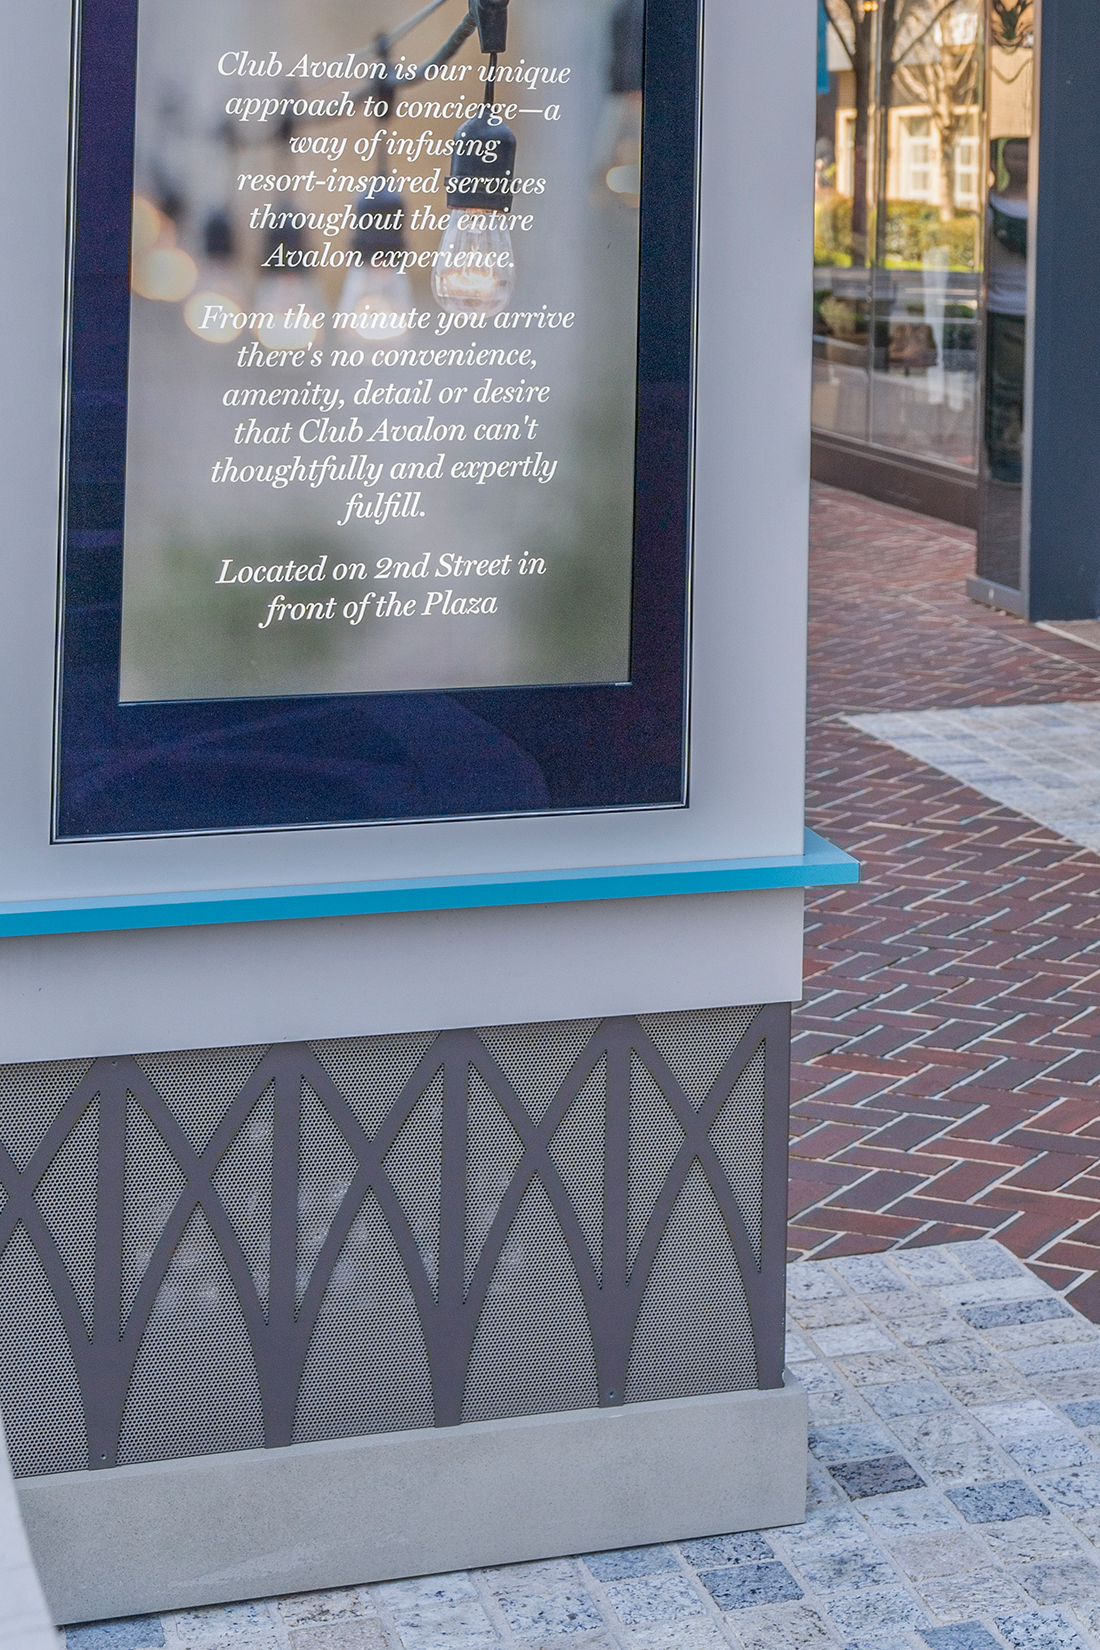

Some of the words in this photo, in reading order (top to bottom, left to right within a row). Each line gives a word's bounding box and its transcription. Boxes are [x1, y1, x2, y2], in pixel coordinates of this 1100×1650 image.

[218, 51, 282, 76] Club
[286, 54, 388, 79] Avalon
[394, 56, 417, 80] is
[424, 64, 472, 81] our
[478, 59, 570, 89] unique
[226, 92, 356, 121] approach
[364, 96, 388, 117] to
[289, 137, 347, 161] way
[354, 129, 387, 161] of
[387, 130, 501, 163] infusing
[238, 168, 441, 199] resort-inspired
[446, 173, 546, 195] services
[250, 204, 404, 236] throughout
[411, 205, 450, 230] the
[457, 209, 533, 233] entire
[261, 242, 364, 267] Avalon
[371, 244, 513, 274] experience.
[198, 306, 275, 329] From
[284, 304, 325, 329] the
[332, 305, 431, 328] minute
[435, 312, 487, 335] you
[494, 305, 575, 328] arrive
[238, 342, 323, 367] there's
[331, 350, 364, 366] no
[372, 342, 536, 369] convenience,
[223, 381, 344, 412] amenity,
[354, 379, 433, 404] detail
[439, 387, 468, 403] or
[474, 378, 550, 403] desire
[235, 419, 293, 444] that
[299, 417, 363, 443] Club
[366, 416, 466, 441] Avalon
[474, 415, 538, 440] can't
[212, 455, 383, 488] thoughtfully
[390, 453, 445, 479] and
[451, 452, 558, 484] expertly
[337, 492, 425, 526] fulfill.
[215, 555, 327, 583] Located
[333, 563, 367, 580] on
[374, 553, 431, 578] 2nd
[435, 553, 512, 577] Street
[518, 551, 546, 574] in
[258, 595, 337, 628] front
[343, 592, 376, 625] of
[376, 592, 416, 617] the
[421, 590, 498, 615] Plaza
